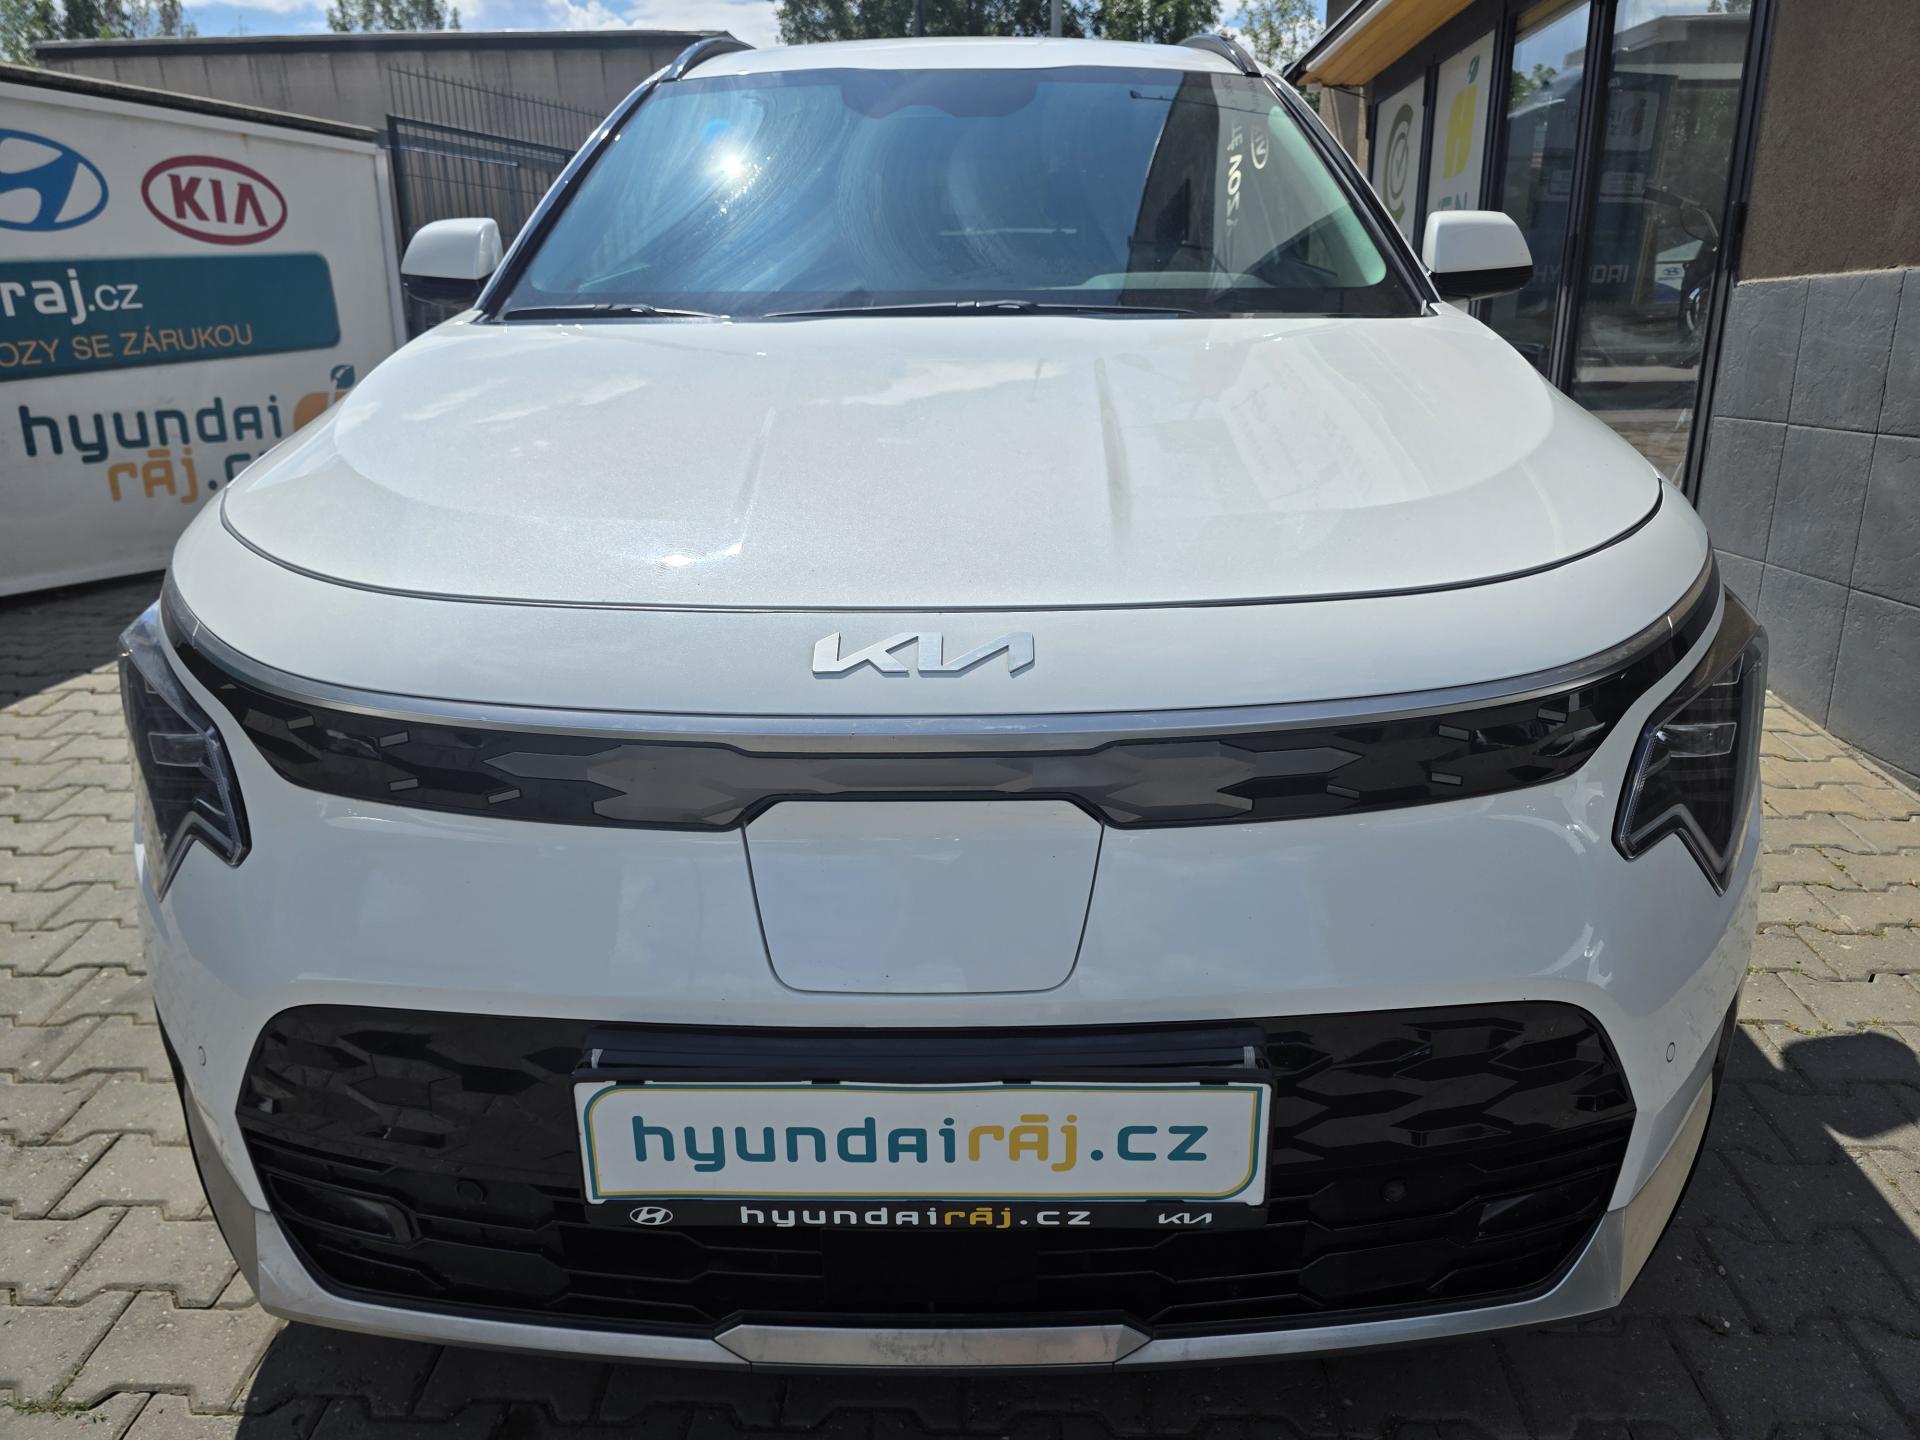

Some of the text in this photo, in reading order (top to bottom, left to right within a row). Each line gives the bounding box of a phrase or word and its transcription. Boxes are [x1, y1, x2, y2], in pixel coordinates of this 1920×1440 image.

[167, 174, 268, 227] KIA
[71, 334, 113, 361] SE
[119, 323, 254, 356] ZÁRUKOU
[18, 395, 282, 465] hyundai
